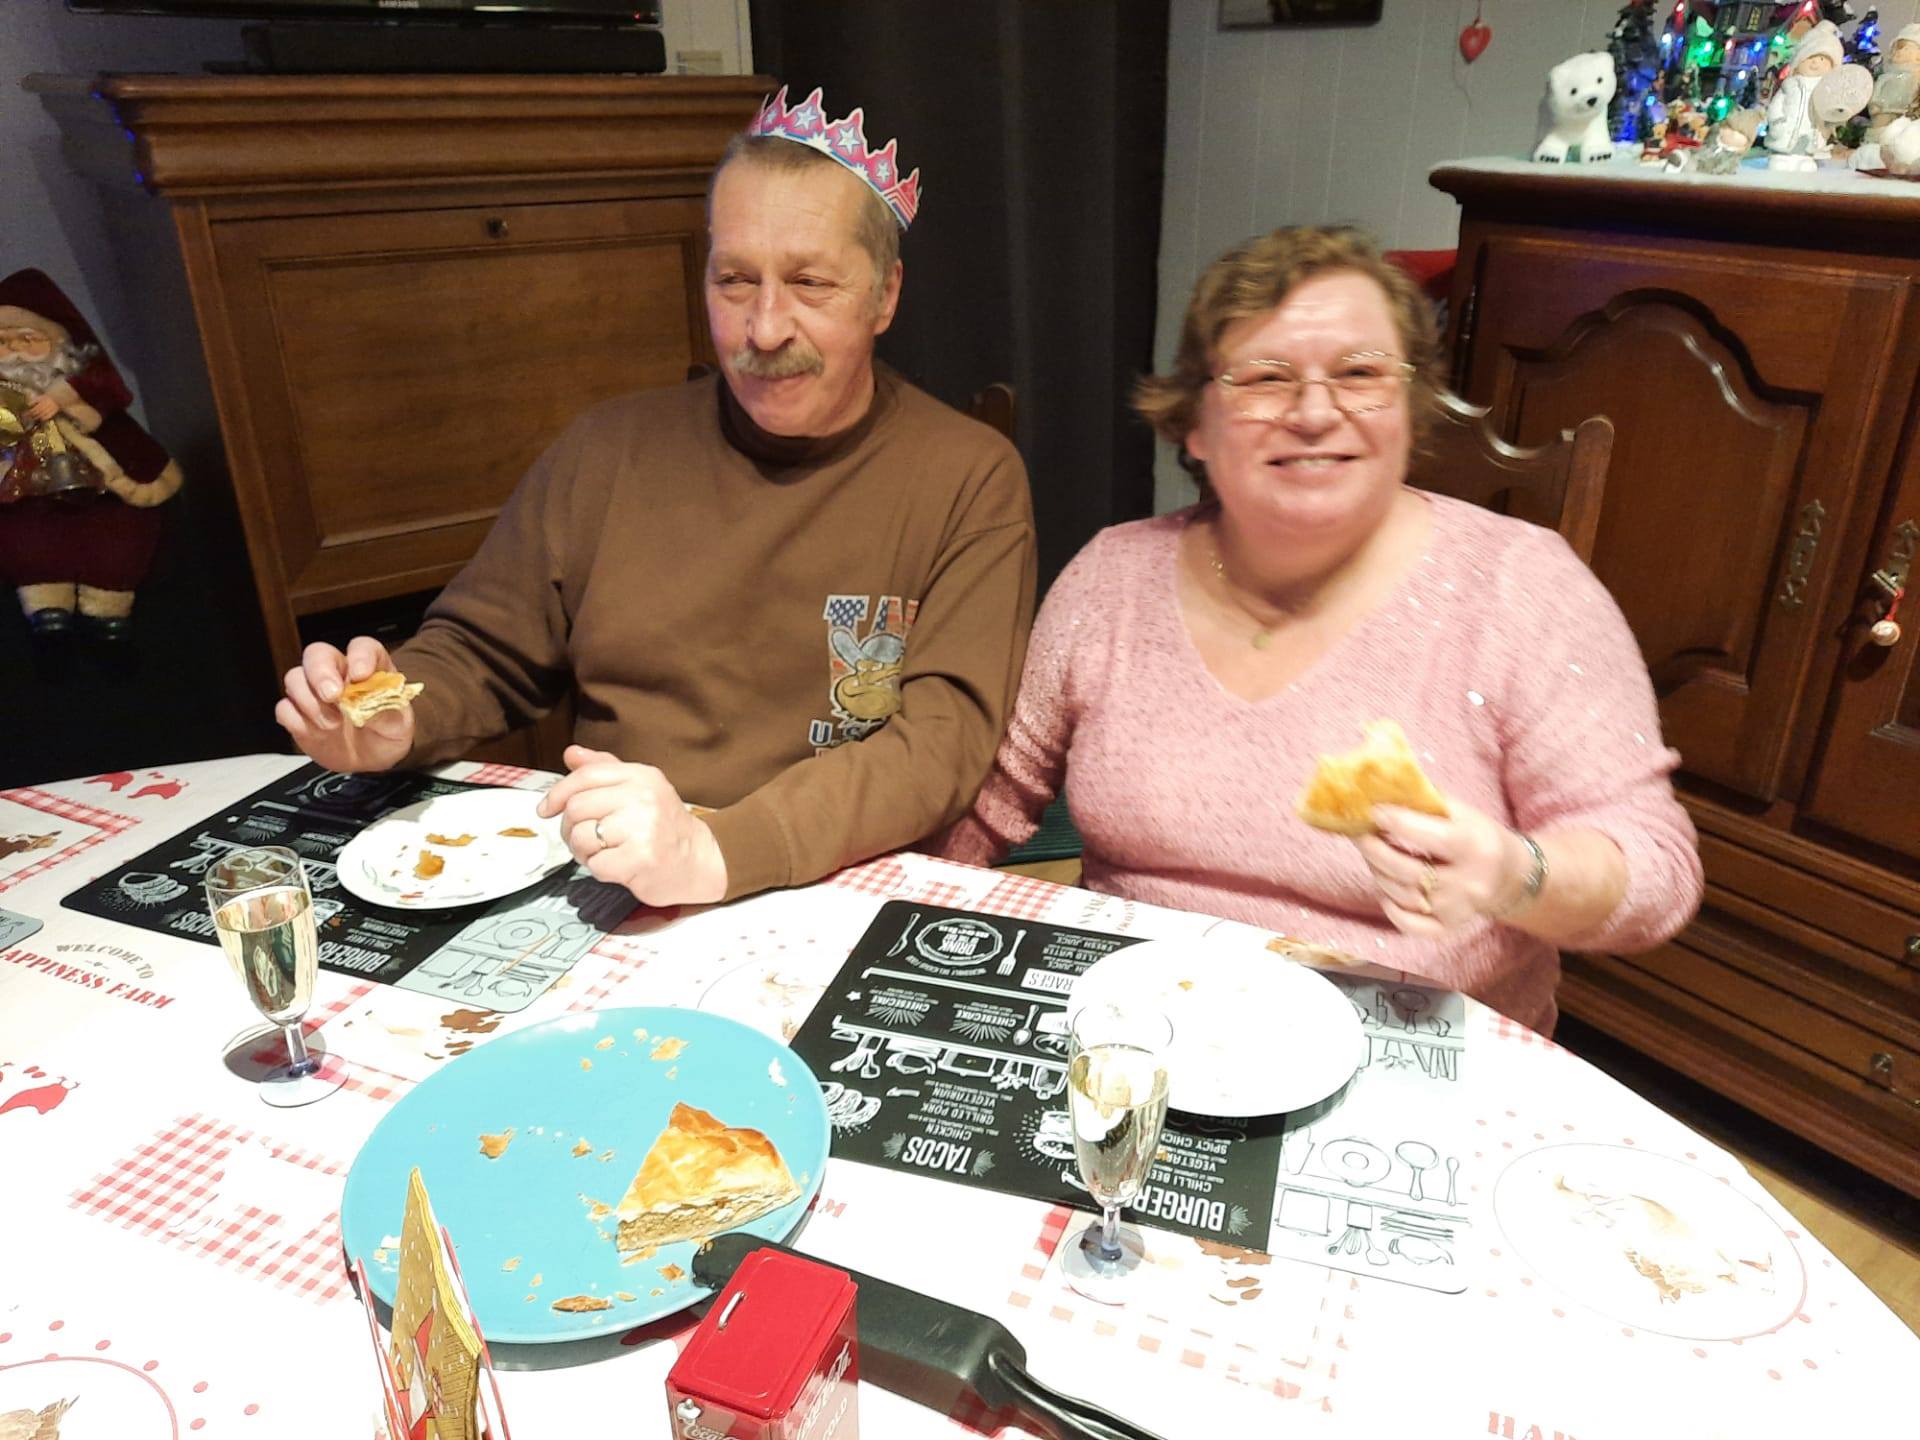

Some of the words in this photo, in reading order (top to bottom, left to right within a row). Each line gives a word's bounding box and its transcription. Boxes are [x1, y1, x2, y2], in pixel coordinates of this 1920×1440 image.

[937, 940, 977, 956] DRINK
[56, 944, 143, 965] WELCOME
[136, 963, 154, 980] TO
[317, 941, 392, 973] BURGERS
[0, 949, 110, 990] APPINESS
[105, 982, 176, 1009] FARM
[1028, 972, 1074, 992] RAGES
[932, 1087, 996, 1108] VEGETARIAN
[921, 1102, 949, 1119] PORK
[951, 1109, 995, 1125] GRILLED
[925, 1123, 972, 1141] CHICKEN
[1160, 1133, 1193, 1148] CHIC
[902, 1136, 973, 1174] TACOS
[1195, 1140, 1228, 1155] SPICY
[1148, 1169, 1171, 1184] BEE
[1174, 1175, 1212, 1192] CHILLI
